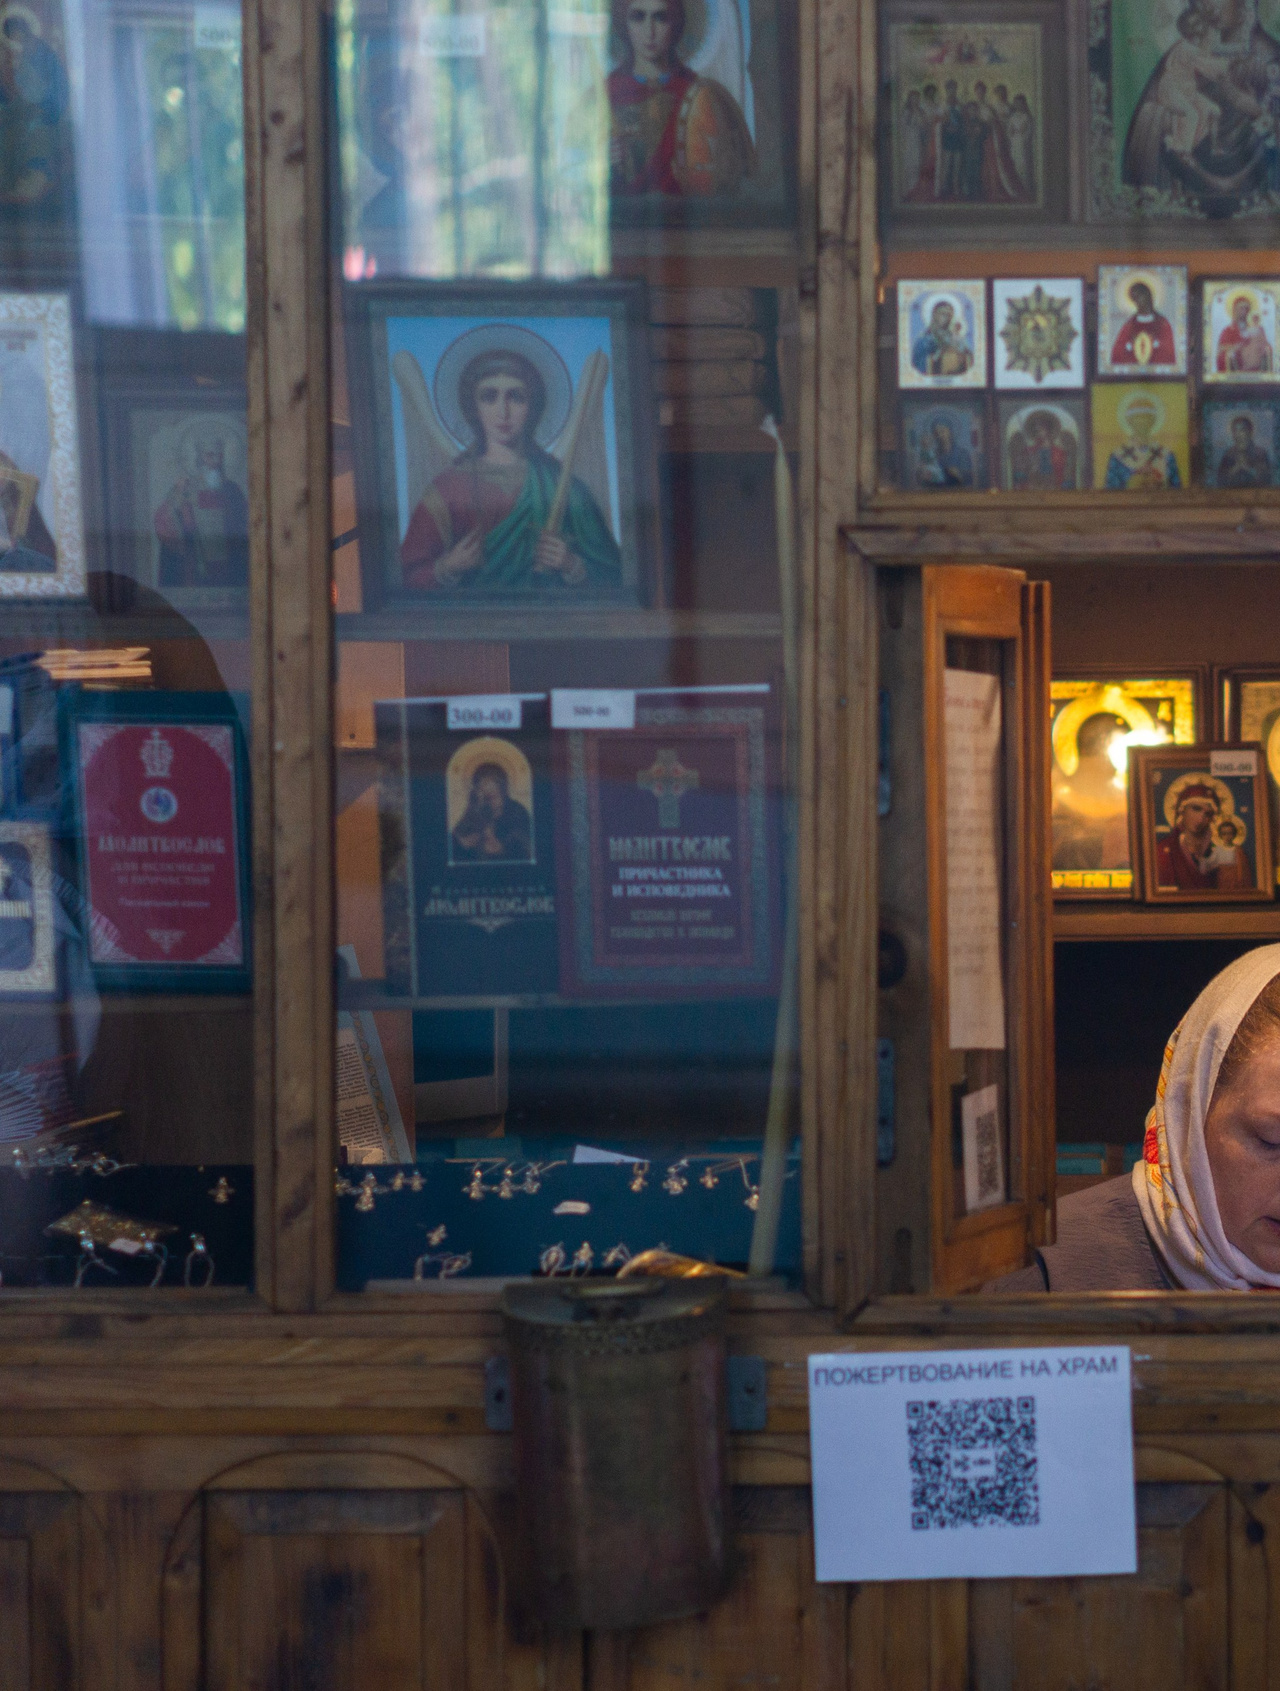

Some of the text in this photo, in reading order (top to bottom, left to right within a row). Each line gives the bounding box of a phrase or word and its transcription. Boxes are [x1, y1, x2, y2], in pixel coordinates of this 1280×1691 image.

[813, 1355, 1119, 1387] ПОЖЕРТВОВАНИЕ НА ХРАМ
